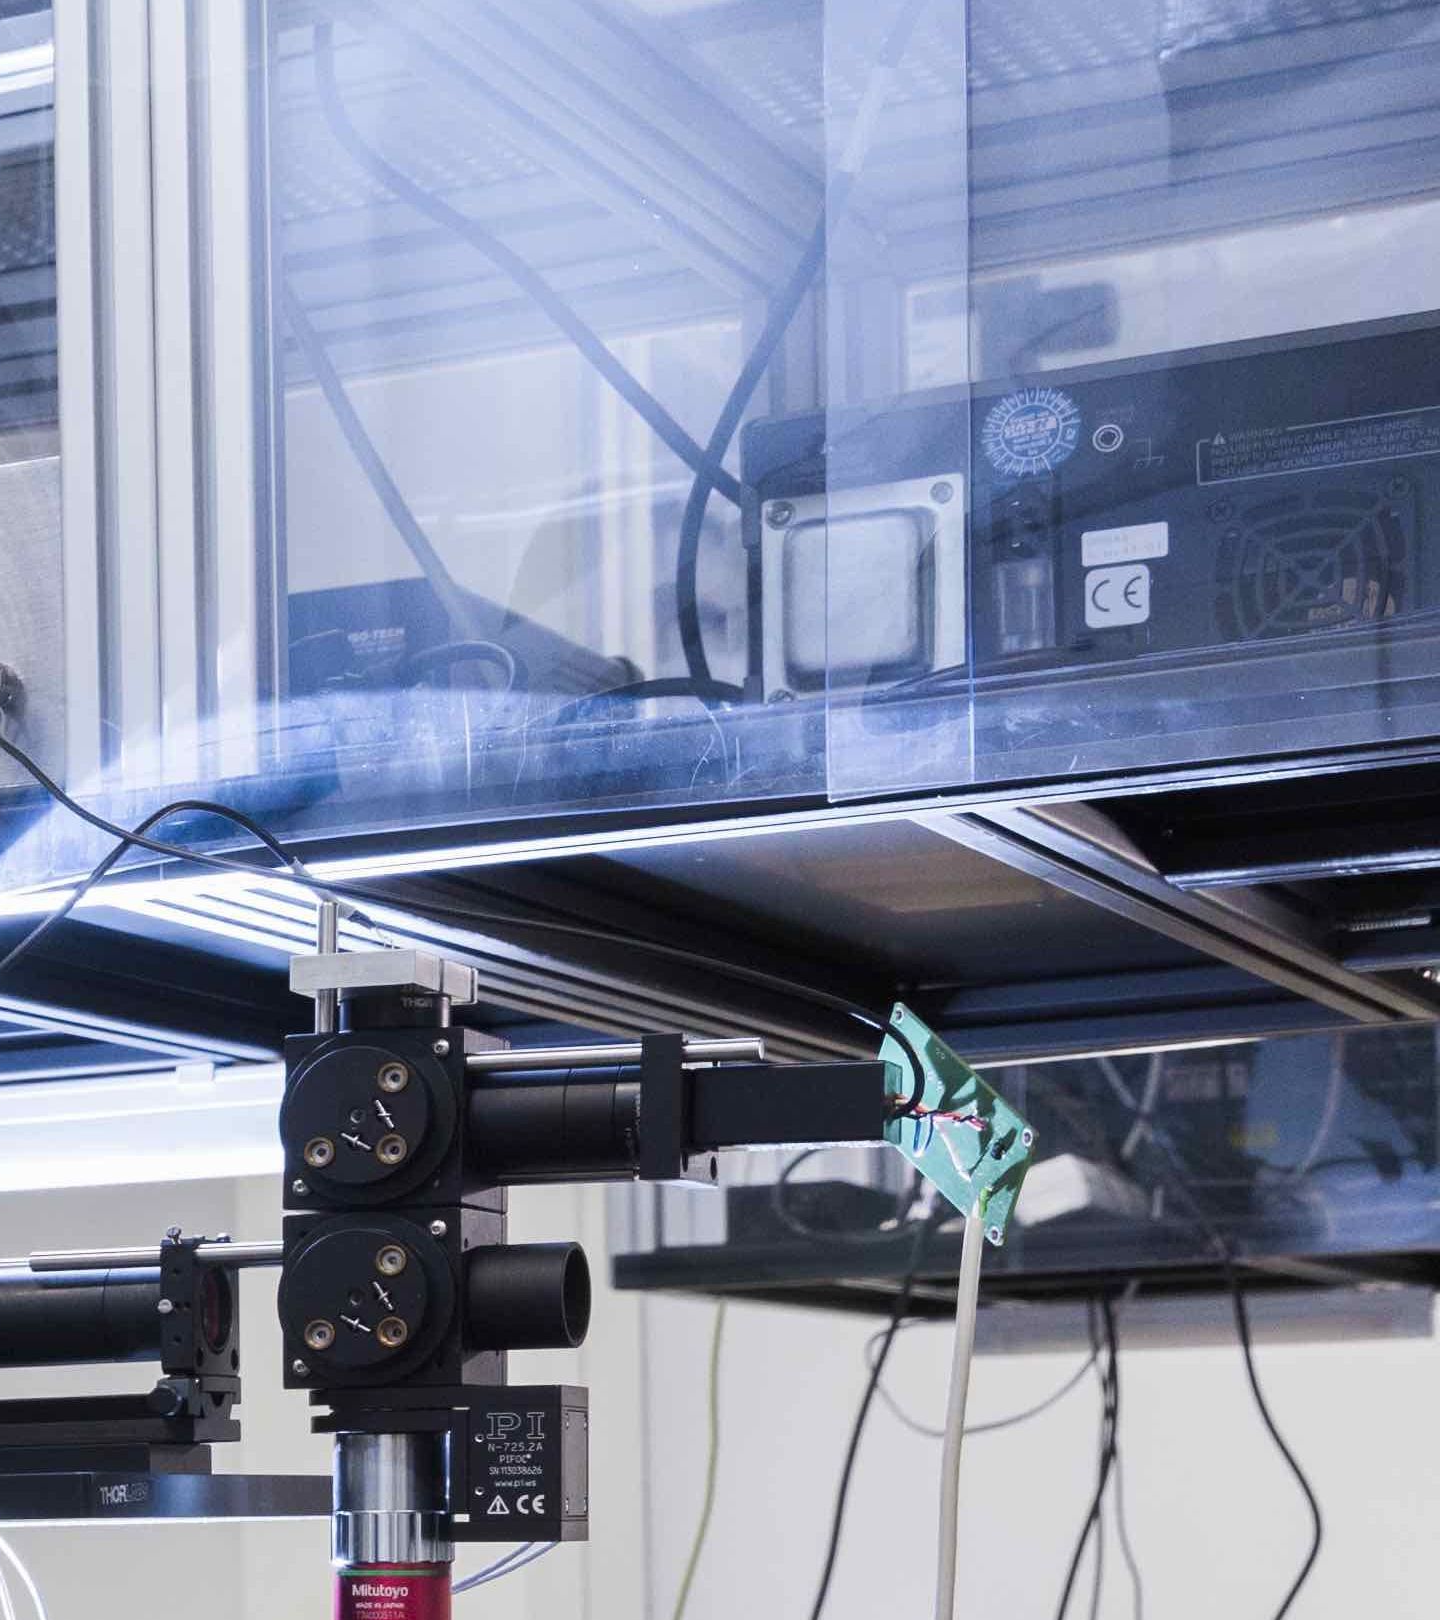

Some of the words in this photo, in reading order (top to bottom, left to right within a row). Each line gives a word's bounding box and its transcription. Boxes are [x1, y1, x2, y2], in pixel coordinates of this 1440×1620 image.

[487, 1411, 545, 1439] PI
[488, 1442, 543, 1452] N-725.2A
[352, 1583, 409, 1599] Mitutoyo
